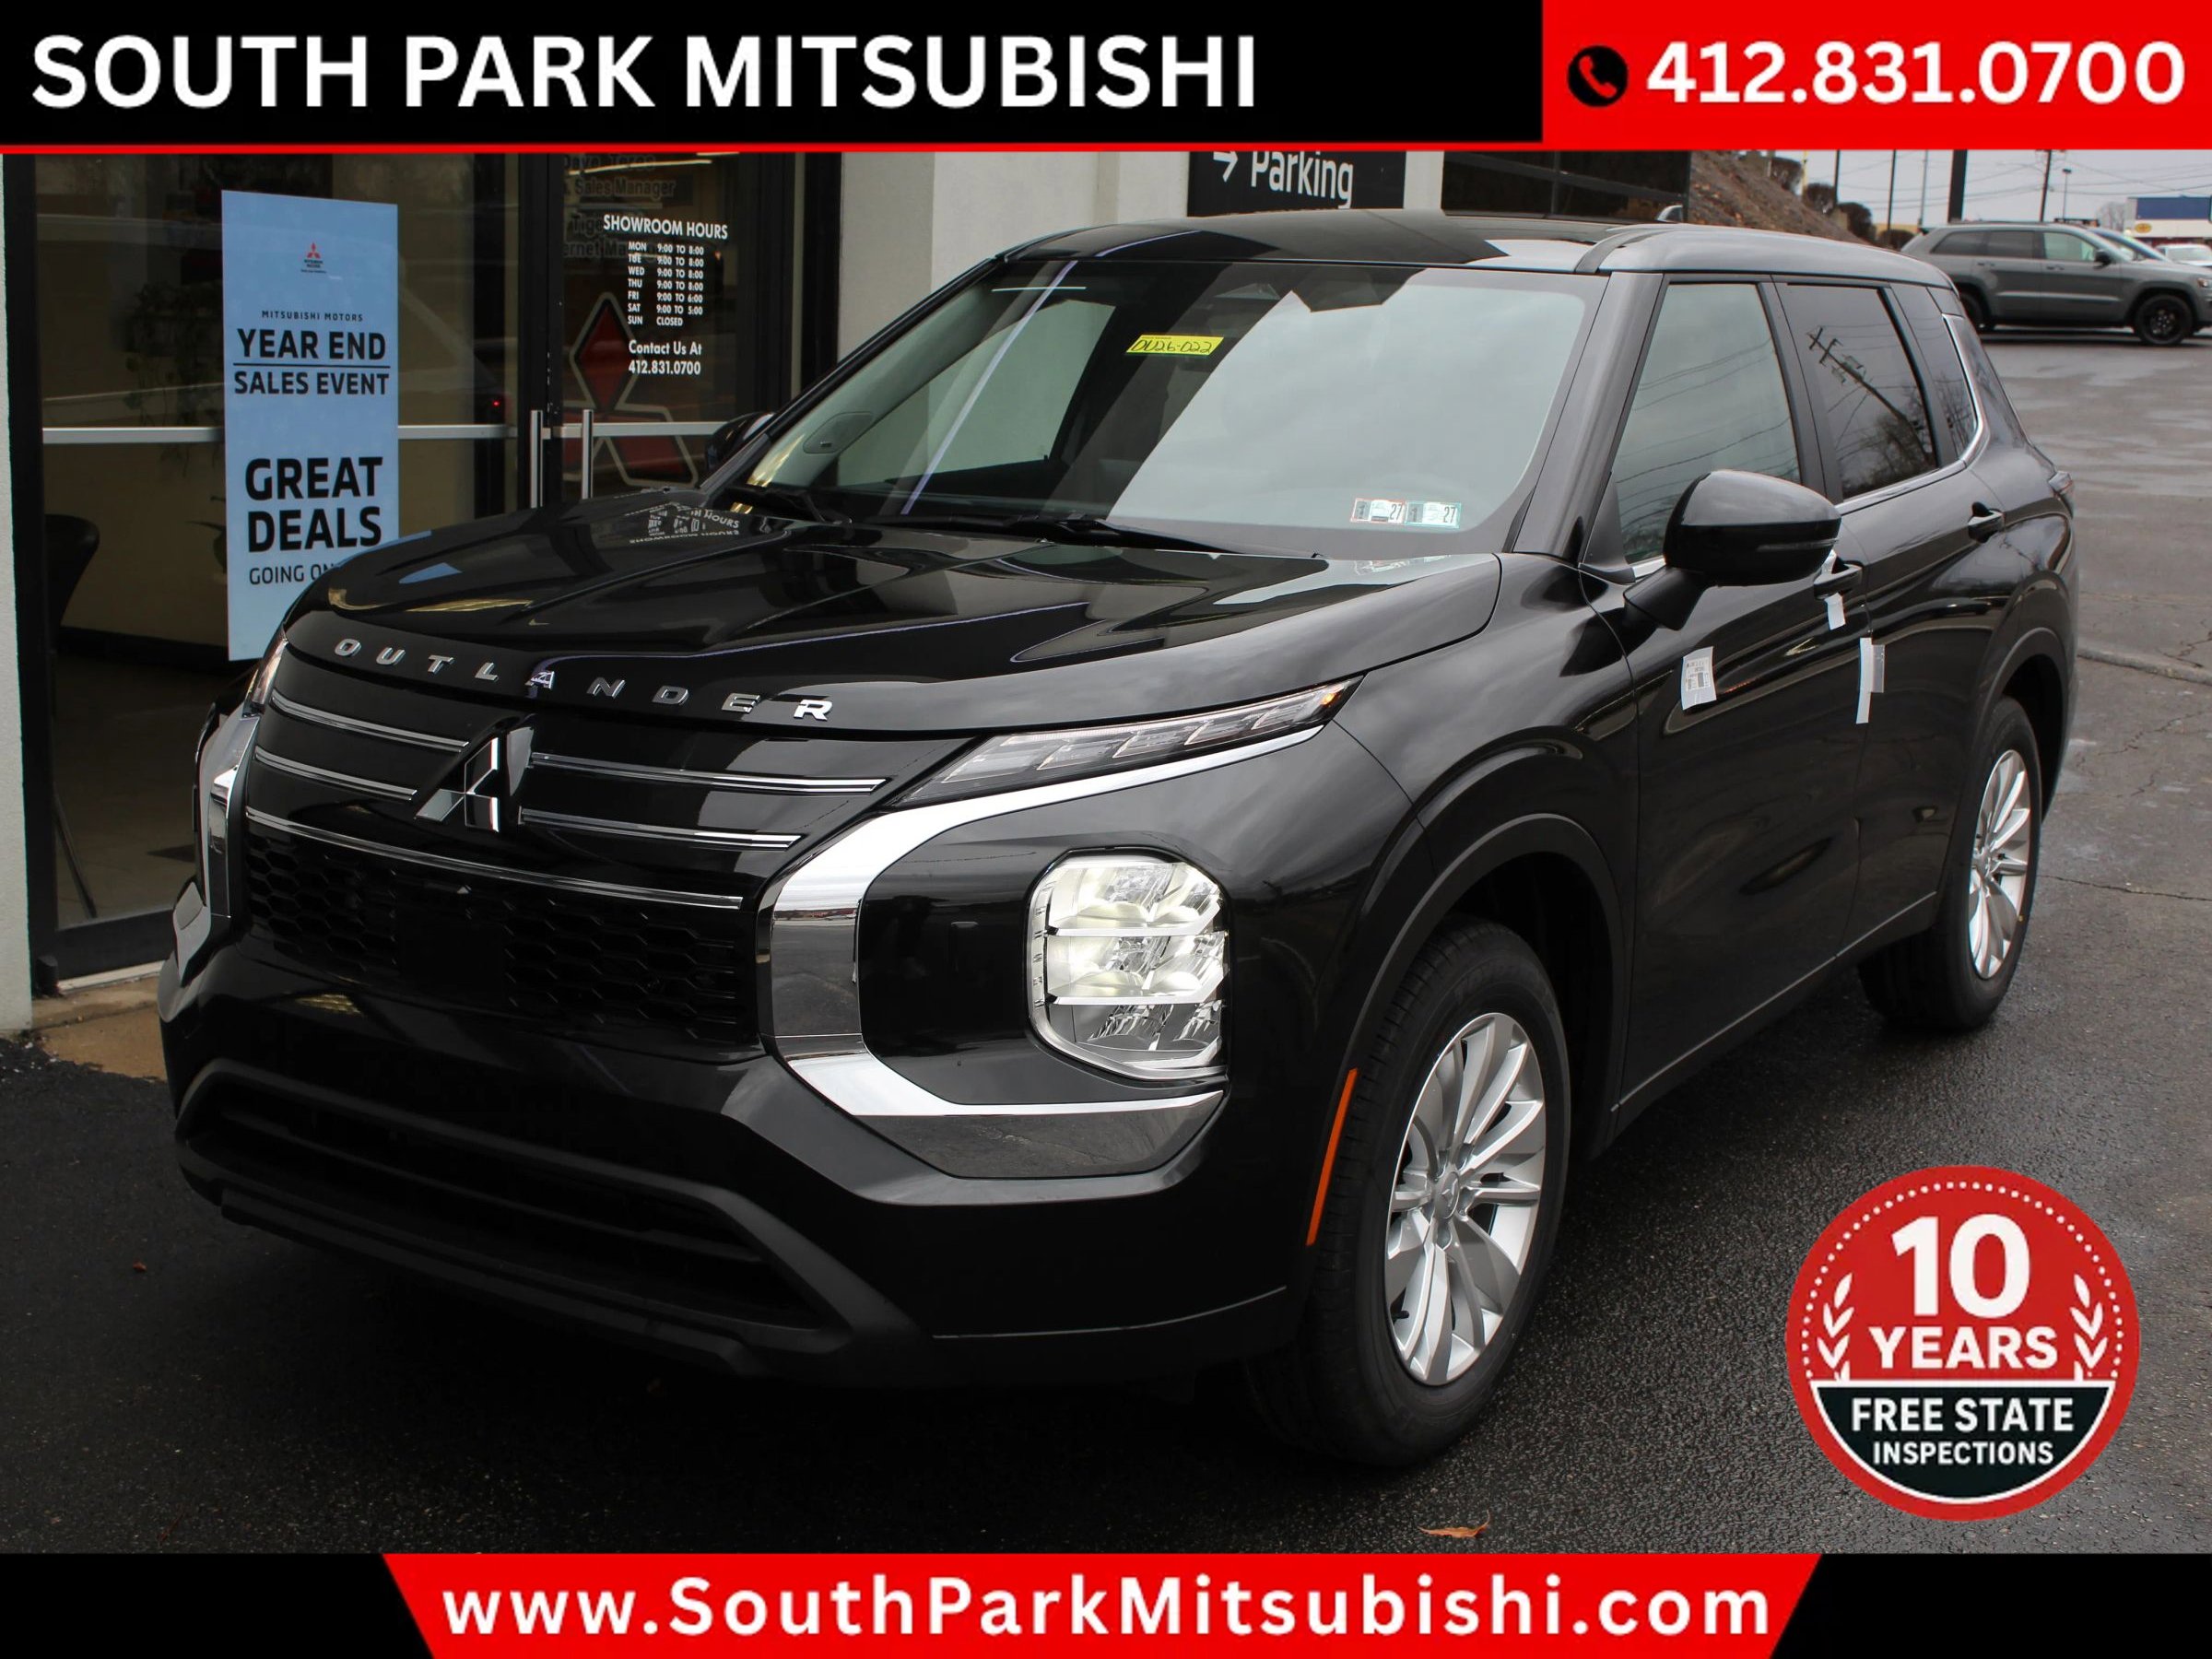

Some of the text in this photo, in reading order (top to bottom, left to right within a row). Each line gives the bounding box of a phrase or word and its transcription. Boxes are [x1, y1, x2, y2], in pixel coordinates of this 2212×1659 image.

[575, 179, 611, 195] Sales
[615, 179, 675, 198] Manager
[1251, 151, 1354, 209] Parking
[604, 214, 728, 240] SHOWROOM HOURS
[629, 241, 646, 251] MON
[657, 243, 673, 253] 9:00
[677, 245, 686, 254] TO
[629, 253, 641, 263] TUE
[657, 255, 672, 265] 9:00
[676, 257, 685, 266] TO
[629, 266, 644, 276] WED
[657, 268, 672, 277] 9:00
[676, 269, 685, 278] TO
[628, 278, 642, 288] THU
[657, 280, 672, 289] 9:00
[676, 281, 685, 290] TO
[628, 291, 639, 300] FRI
[657, 292, 672, 301] 9:00
[676, 293, 685, 302] TO
[262, 310, 363, 323] MITSUBISHI MOTORS
[628, 303, 641, 312] SAT
[656, 305, 672, 314] 9:00
[675, 305, 684, 314] TO
[628, 315, 683, 326] SUN CLOSED
[238, 328, 385, 360] YEAR END
[629, 339, 702, 356] Contact Us At
[629, 359, 701, 375] 412.831.0700
[234, 371, 390, 395] SALES EVENT
[245, 456, 383, 501] GREAT
[1390, 503, 1403, 521] 27
[1443, 506, 1456, 523] 27
[247, 506, 382, 555] DEALS
[250, 564, 304, 585] GOING
[334, 637, 833, 721] OUTLANDER
